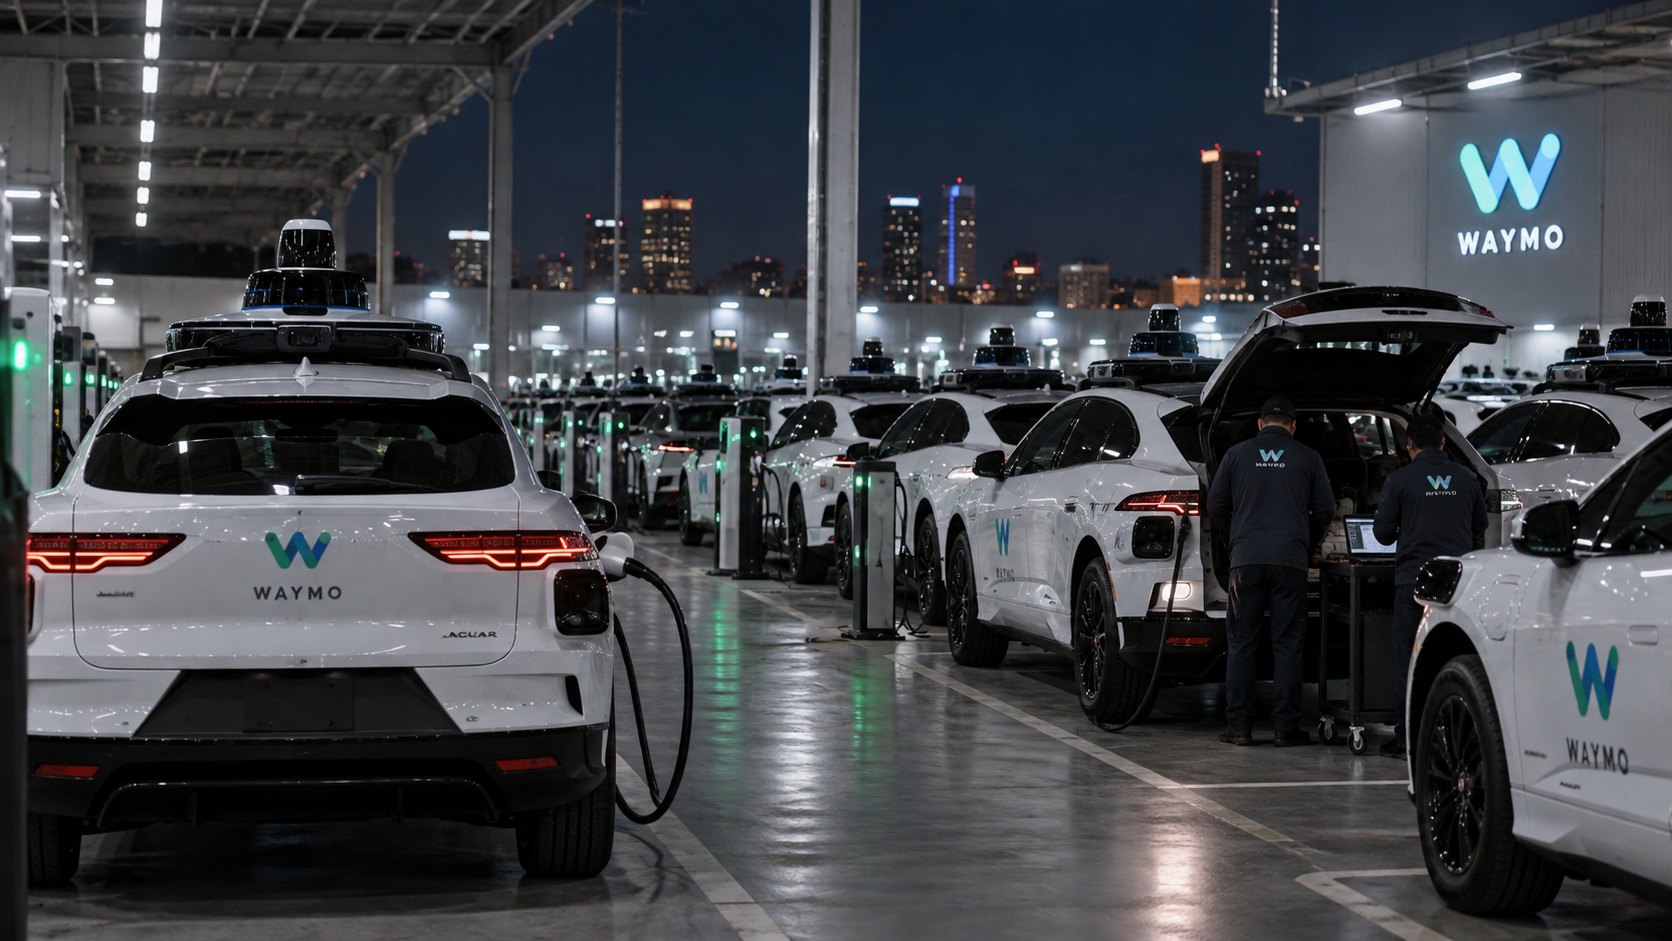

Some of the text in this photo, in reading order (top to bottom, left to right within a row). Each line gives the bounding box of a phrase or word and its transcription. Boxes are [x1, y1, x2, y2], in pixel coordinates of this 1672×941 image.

[1458, 225, 1563, 255] WAYMO
[253, 586, 342, 600] WAYMO
[1566, 737, 1629, 775] WAYMO
